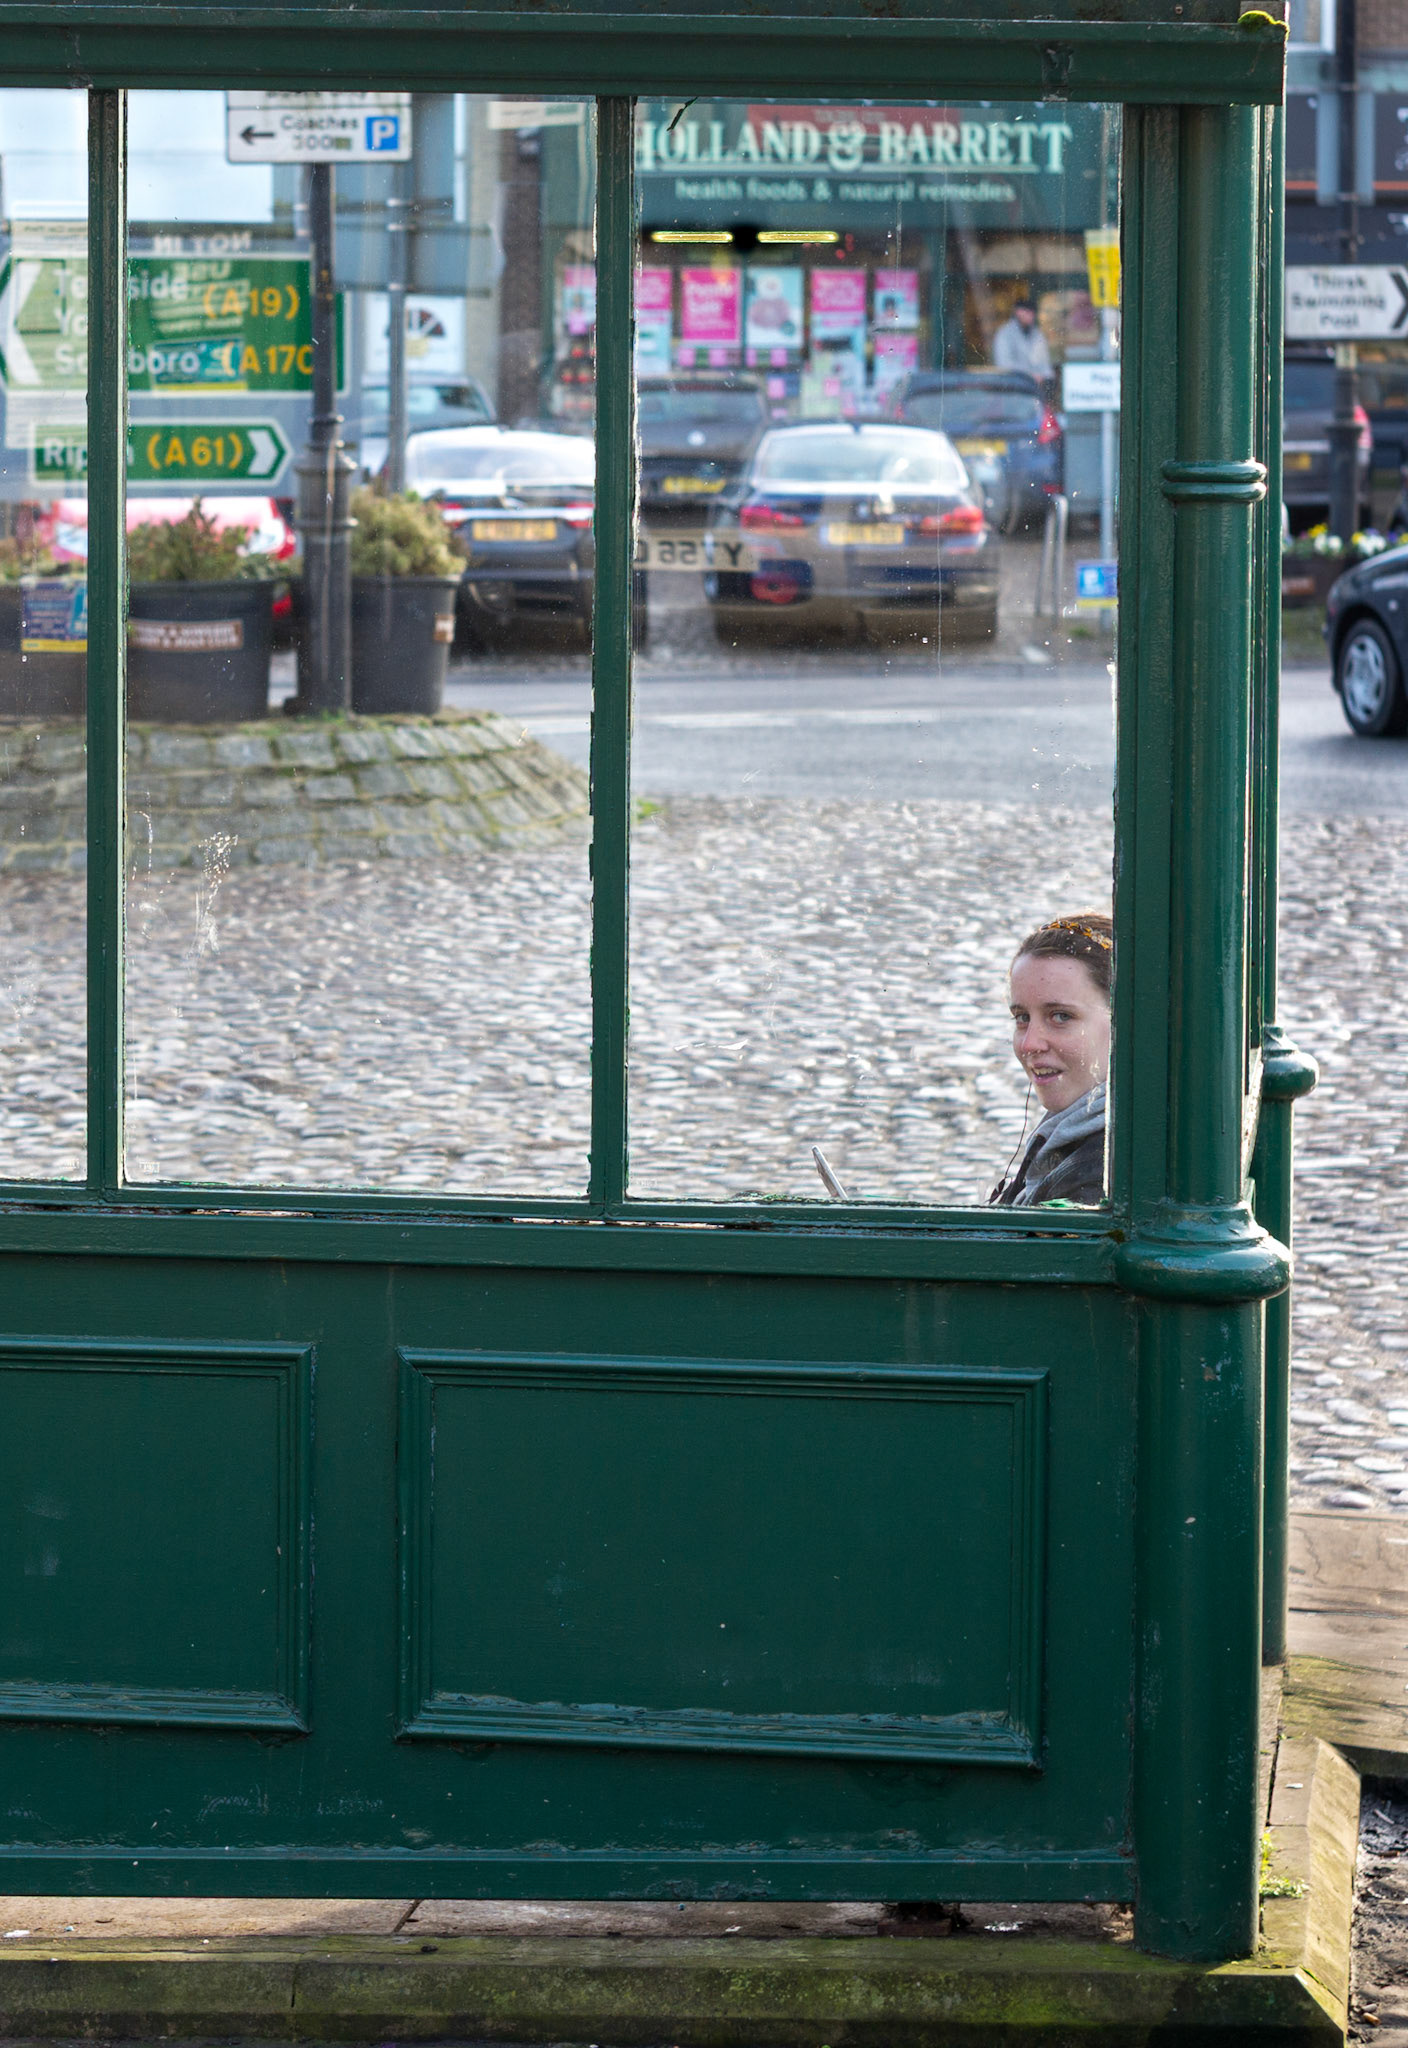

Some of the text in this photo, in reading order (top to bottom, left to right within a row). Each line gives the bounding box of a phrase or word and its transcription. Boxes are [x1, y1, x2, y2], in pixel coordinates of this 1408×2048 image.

[280, 114, 359, 131] Coaches
[371, 119, 396, 149] P
[827, 119, 867, 172] &
[878, 120, 1074, 174] BARRETT
[675, 177, 1017, 201] health foods & natural remedies
[1311, 273, 1367, 289] Thirsk
[53, 269, 188, 300] Teside
[203, 285, 300, 320] (A19)
[1291, 293, 1387, 311] Swimming
[1319, 313, 1360, 327] Pool
[147, 433, 243, 470] (A61)
